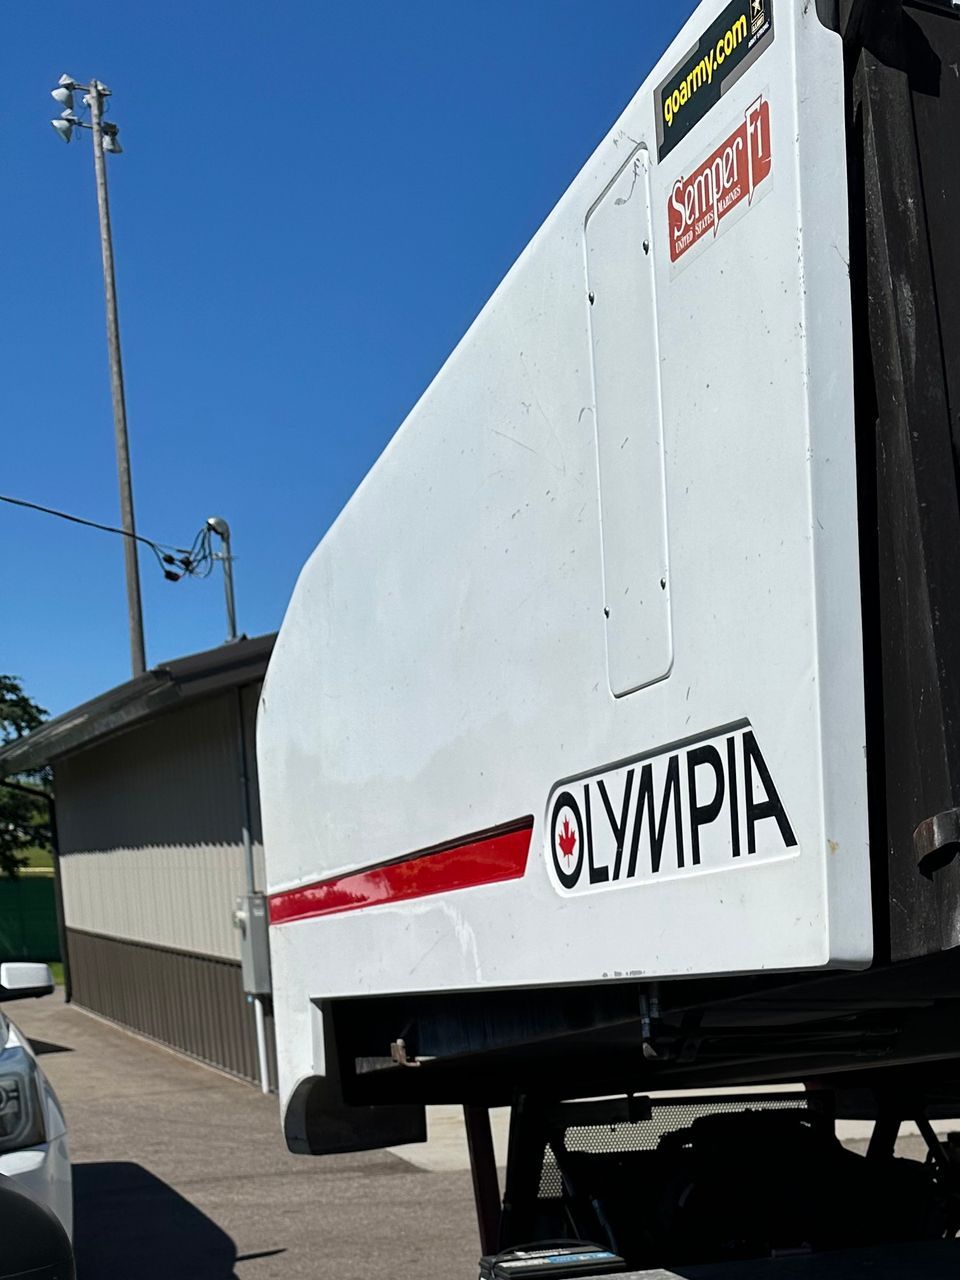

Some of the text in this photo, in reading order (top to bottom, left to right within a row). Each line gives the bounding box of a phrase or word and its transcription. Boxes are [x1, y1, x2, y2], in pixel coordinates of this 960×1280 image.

[664, 14, 748, 127] goarmy.com
[672, 136, 743, 238] Semper
[675, 185, 741, 253] UNITED STATES MARINES
[550, 730, 798, 890] OLYMPIA
